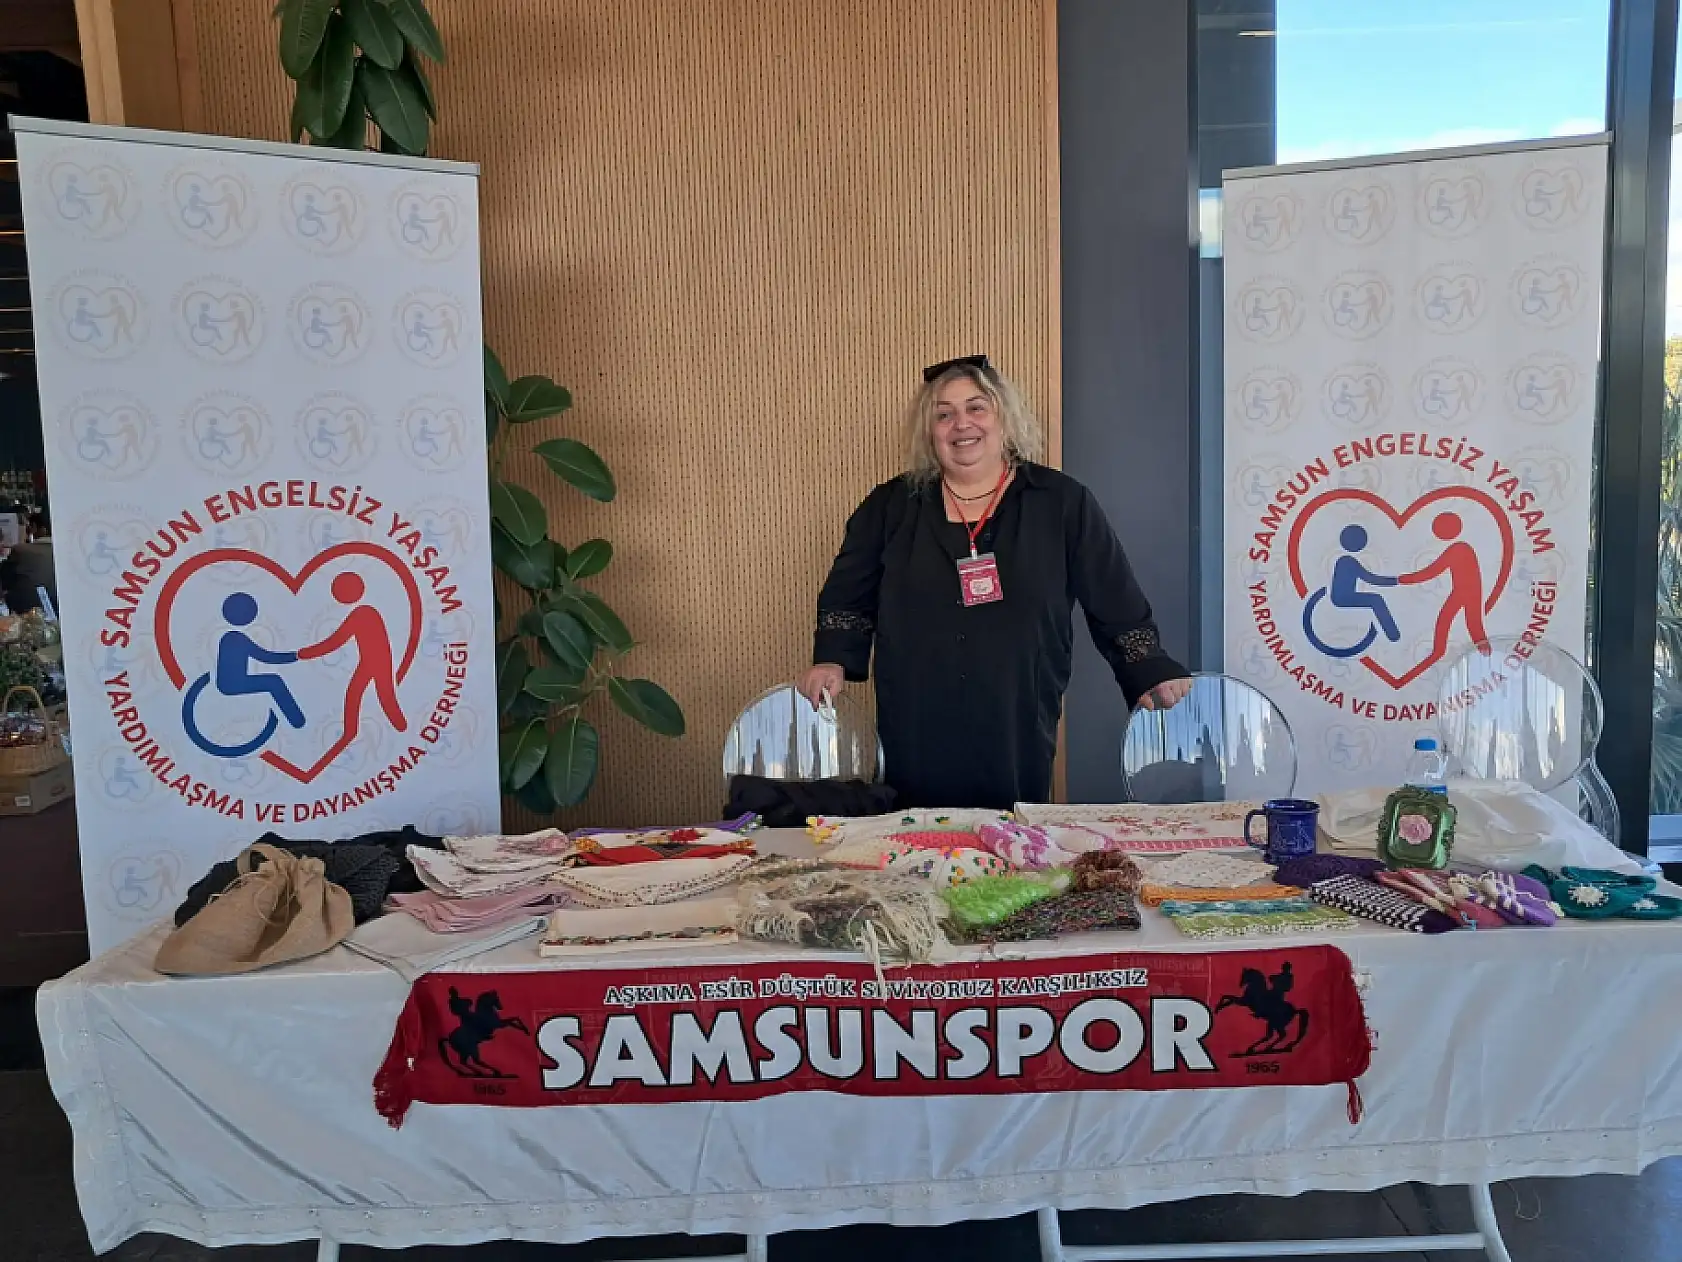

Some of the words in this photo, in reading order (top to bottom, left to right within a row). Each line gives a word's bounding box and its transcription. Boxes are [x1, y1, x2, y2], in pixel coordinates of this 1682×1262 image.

[100, 511, 203, 648] SAMSUN
[204, 480, 382, 524] ENGELSİZ
[386, 512, 463, 614] YAŞAM
[1249, 457, 1330, 563] SAMSUN
[1332, 433, 1484, 471] ENGELSİZ
[1486, 460, 1556, 554] YAŞAM
[1248, 580, 1344, 709] YARDIMLAŞMA
[1352, 698, 1376, 719] VE
[1503, 579, 1558, 672] DERNEĞİ
[104, 671, 245, 820] YARDIMLAŞMA
[254, 804, 285, 823] VE
[293, 746, 427, 824] DAYANIŞMA
[419, 641, 469, 745] DERNEĞİ
[536, 996, 1219, 1090] SAMSUNSPOR
[603, 983, 697, 1008] AŞKINA
[699, 976, 756, 1001] ESİR
[758, 973, 857, 1001] DÜŞTÜK
[998, 968, 1148, 998] KARŞILIKSIZ
